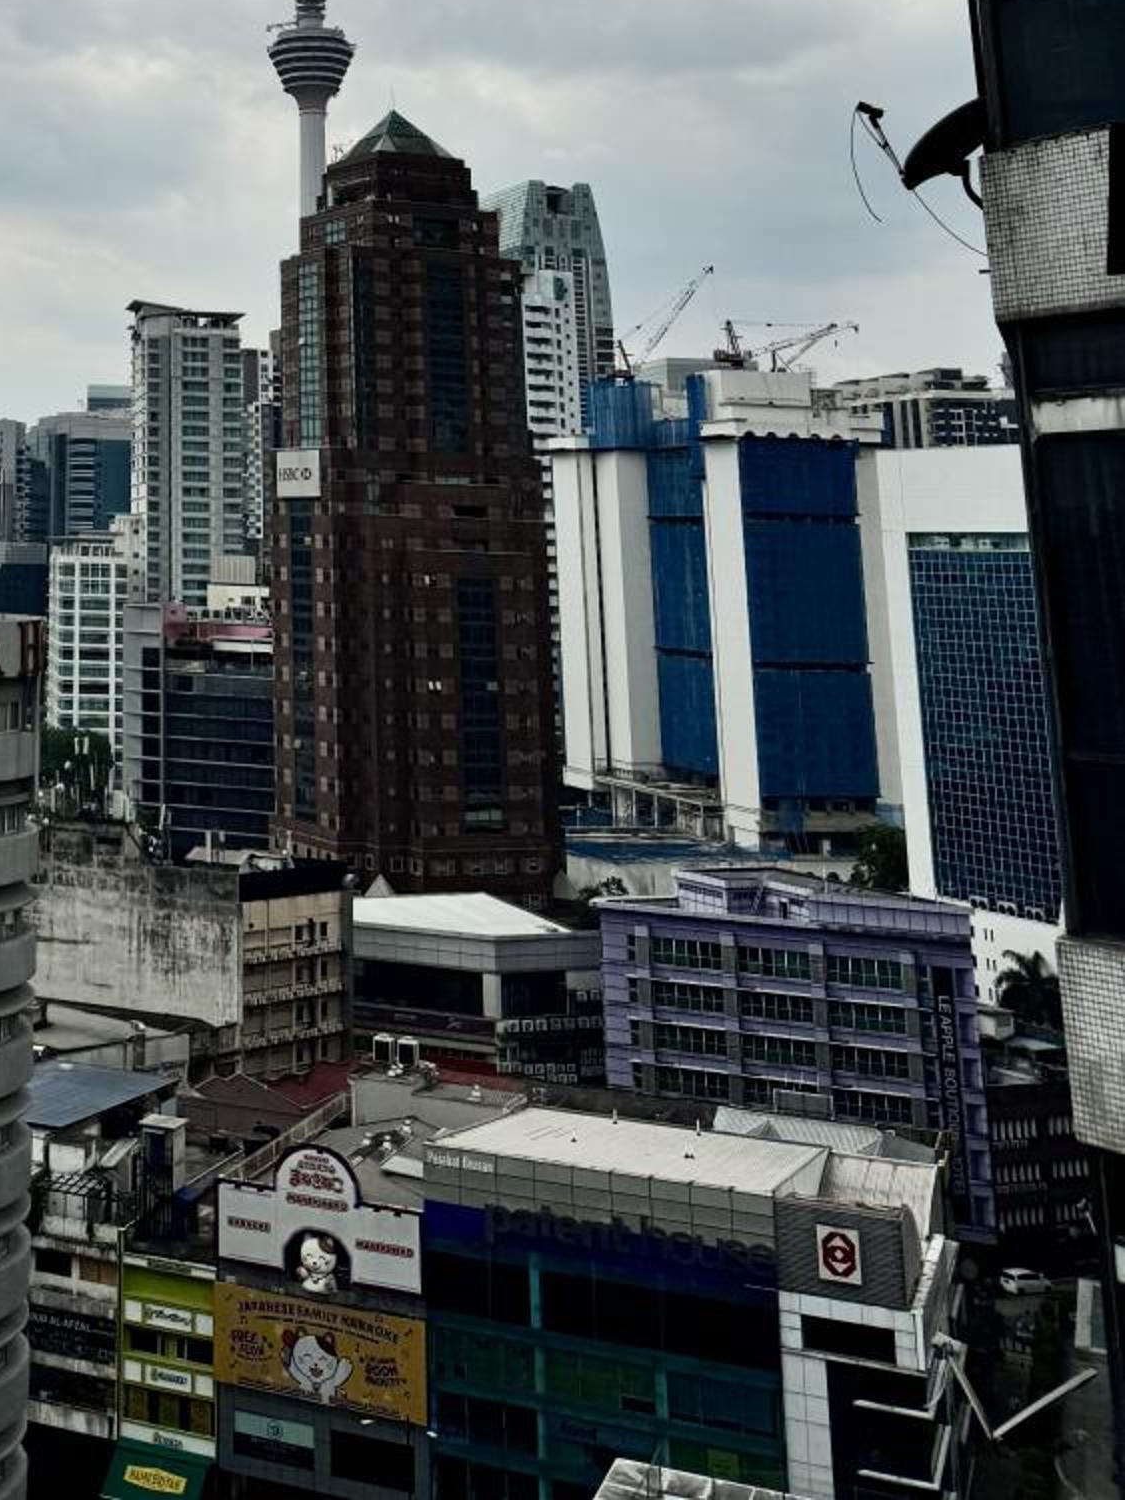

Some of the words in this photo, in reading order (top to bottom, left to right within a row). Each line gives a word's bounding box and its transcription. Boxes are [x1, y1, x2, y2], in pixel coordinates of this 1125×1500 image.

[937, 995, 952, 1014] LE
[939, 1014, 956, 1064] APPLE
[238, 1299, 294, 1316] JAPANESE
[297, 1306, 338, 1324] FAMILY
[340, 1314, 400, 1343] KARAOKE
